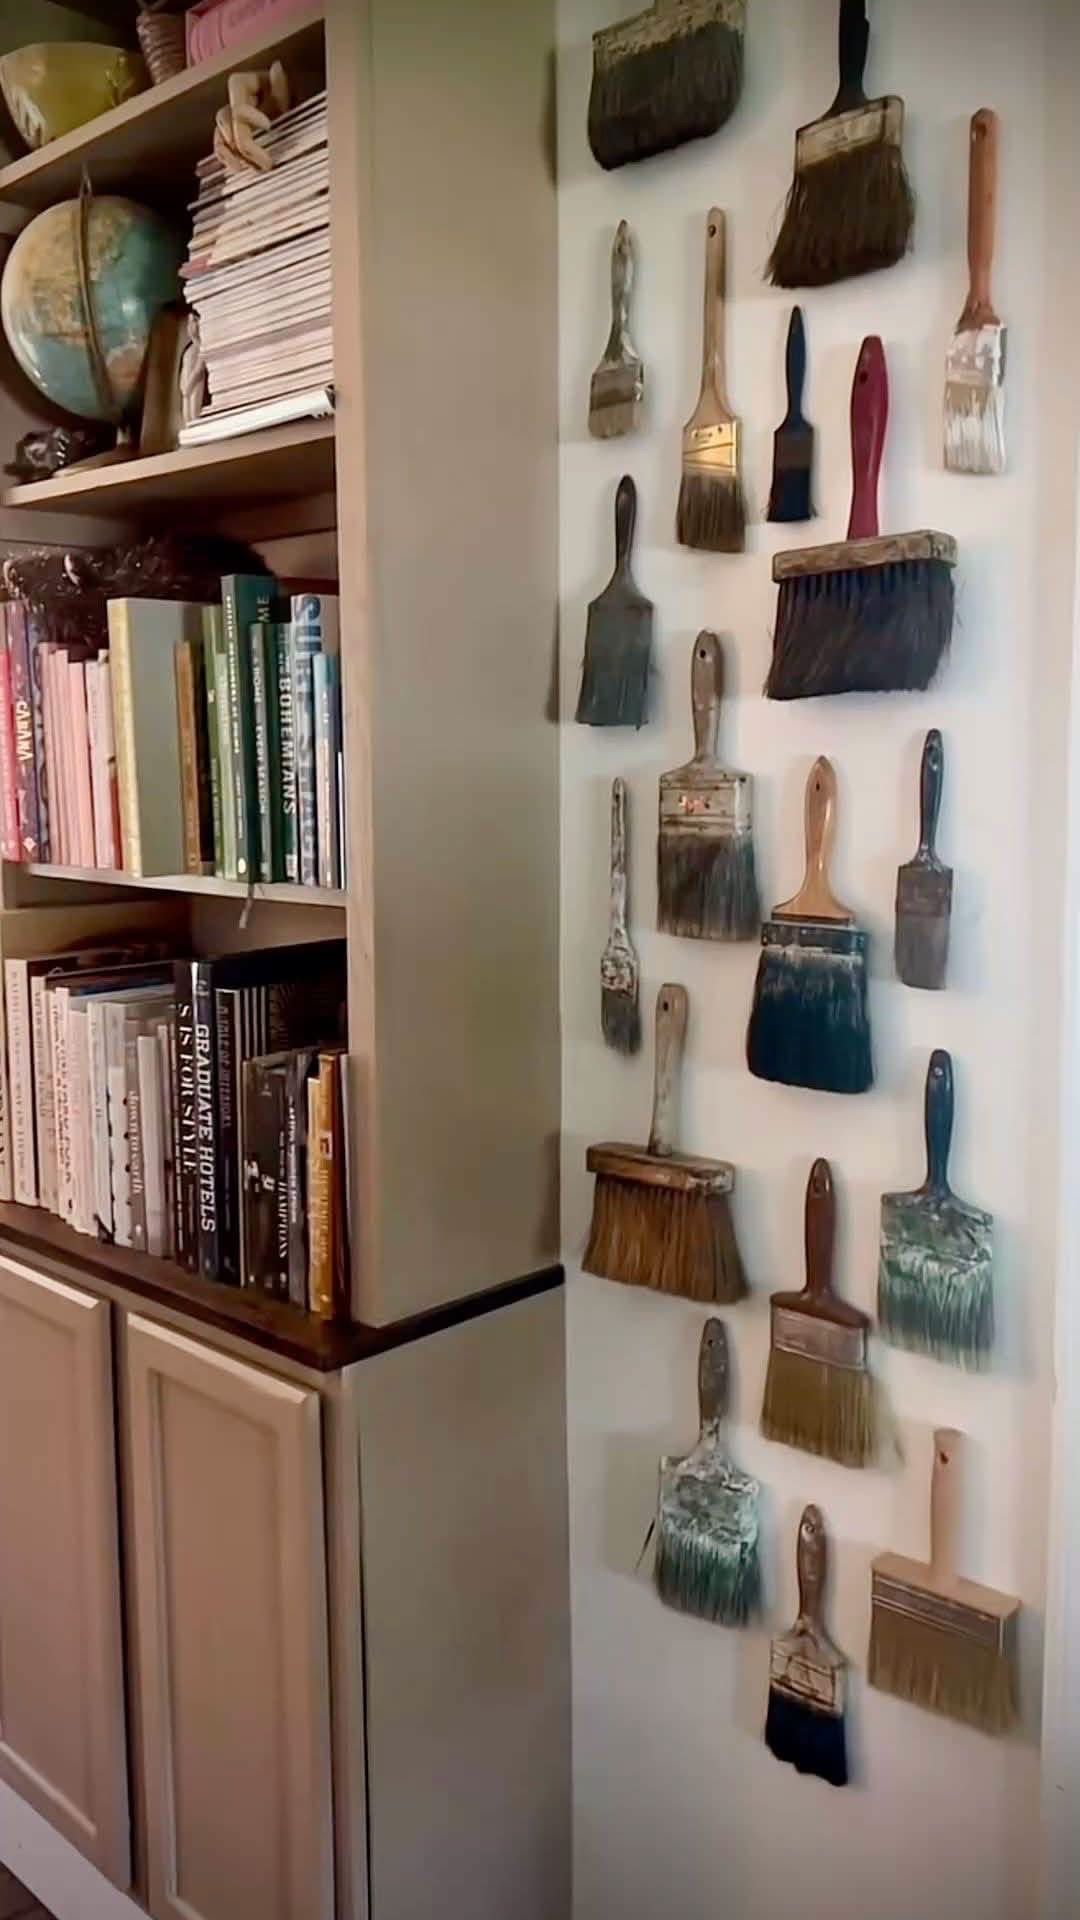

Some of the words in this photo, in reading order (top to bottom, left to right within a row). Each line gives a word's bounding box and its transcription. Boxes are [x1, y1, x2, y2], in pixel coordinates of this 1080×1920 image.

[16, 701, 33, 762] CABANA
[279, 677, 298, 816] BOHEMIANS
[178, 1003, 193, 1017] S
[179, 1026, 193, 1046] IS
[180, 1054, 196, 1097] FOR
[195, 1023, 214, 1141] GRADUATE
[182, 1103, 198, 1175] STYLE
[199, 1146, 216, 1232] HOTELS
